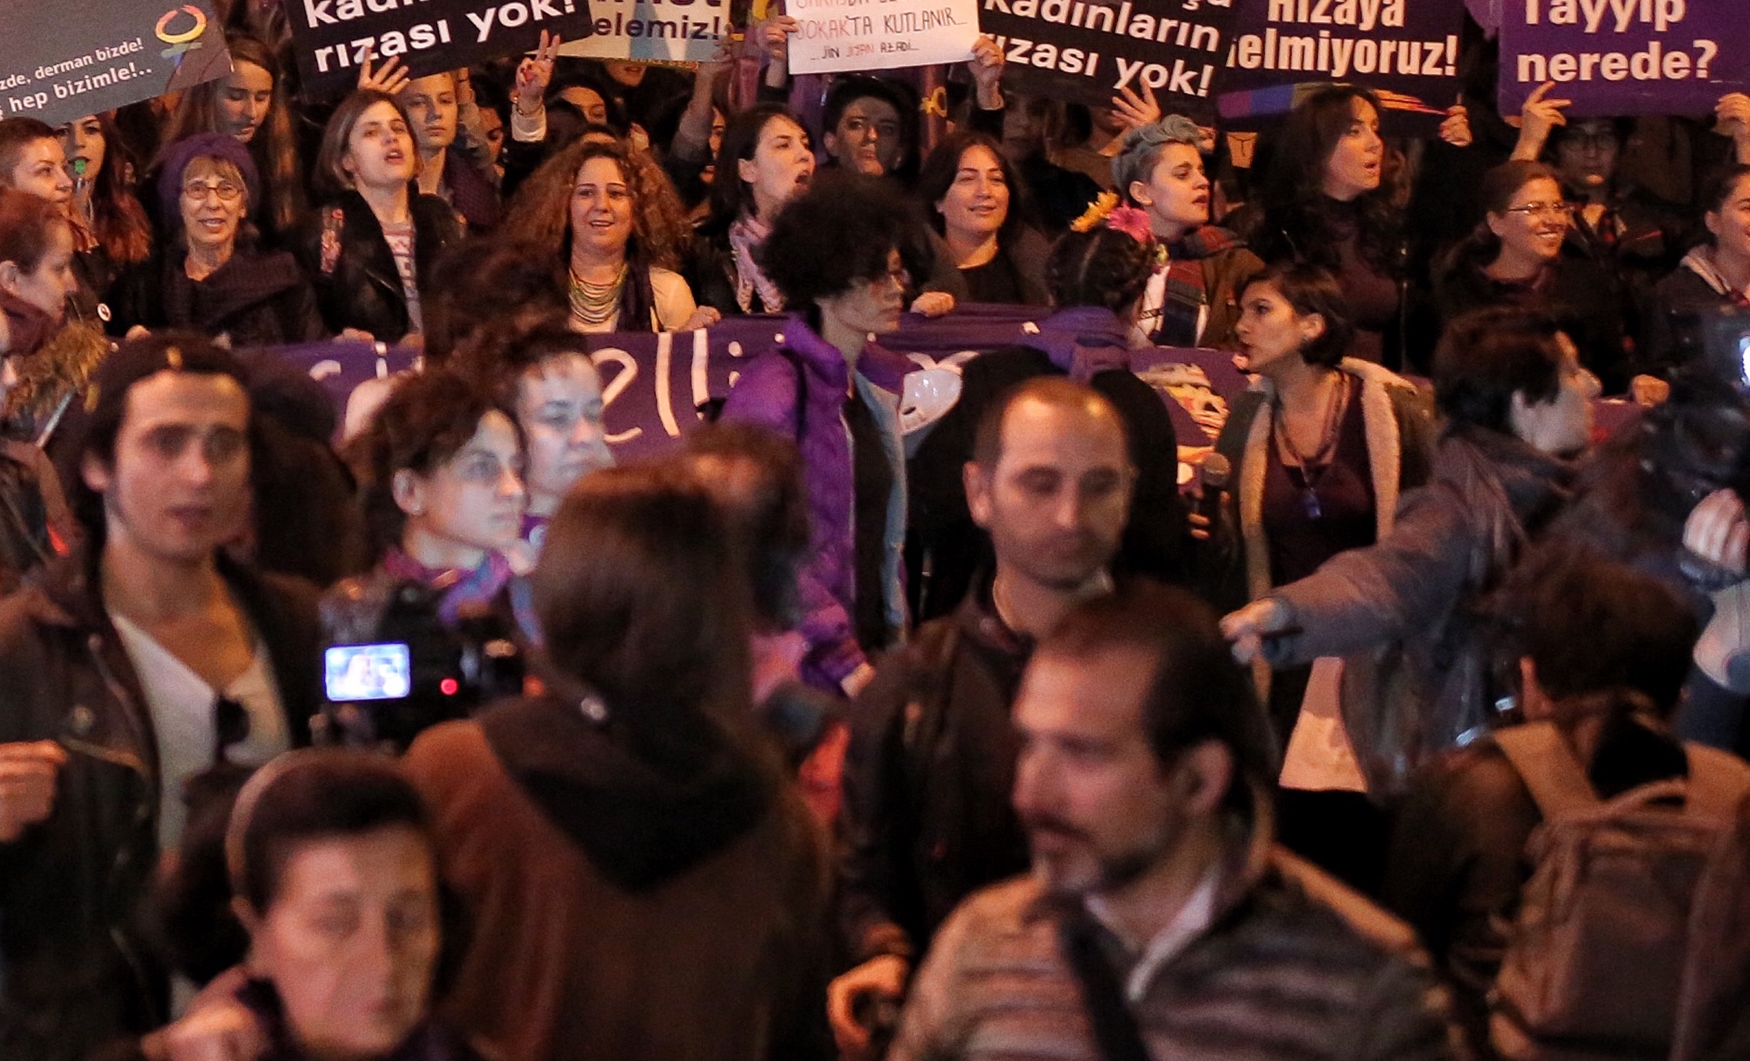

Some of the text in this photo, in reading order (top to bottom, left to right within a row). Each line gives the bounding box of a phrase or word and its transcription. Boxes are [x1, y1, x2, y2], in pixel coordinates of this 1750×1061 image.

[35, 56, 93, 79] derman
[96, 38, 143, 61] bizde!
[313, 21, 450, 72] rızası
[1518, 40, 1721, 82] nerede?
[9, 92, 47, 112] hep
[53, 61, 151, 98] bizimle!..
[1113, 57, 1214, 97] yok!
